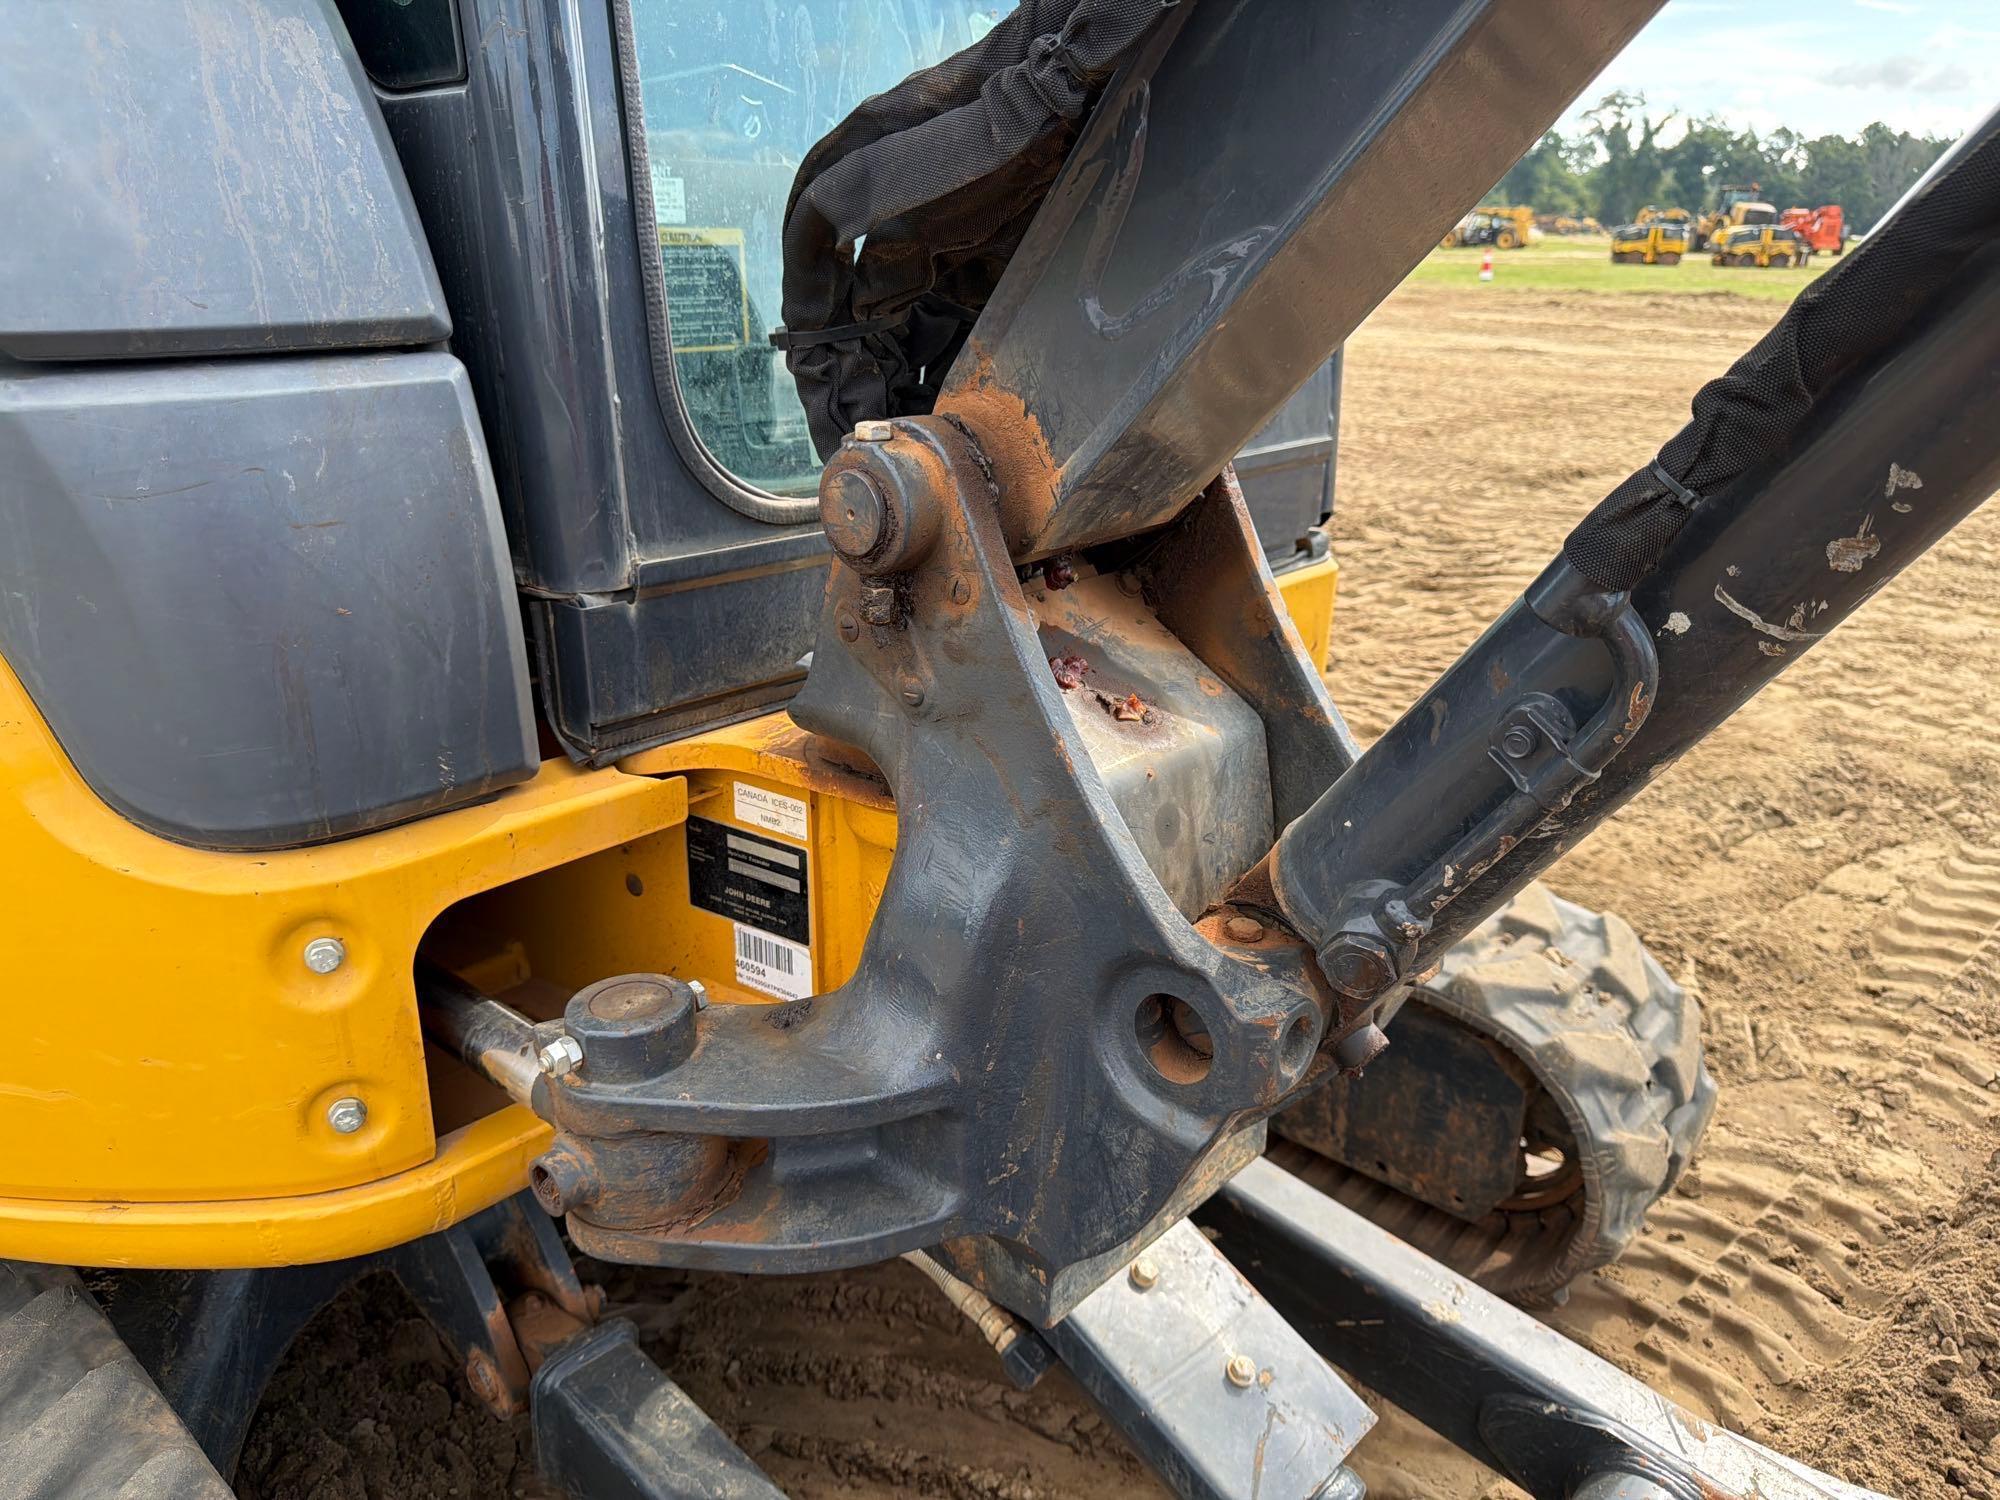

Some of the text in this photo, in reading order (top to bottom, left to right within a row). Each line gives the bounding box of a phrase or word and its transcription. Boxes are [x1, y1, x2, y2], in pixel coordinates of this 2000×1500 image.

[737, 788, 803, 815] CANADA ICES-002
[724, 886, 744, 899] JOHN
[745, 893, 771, 909] DEERE
